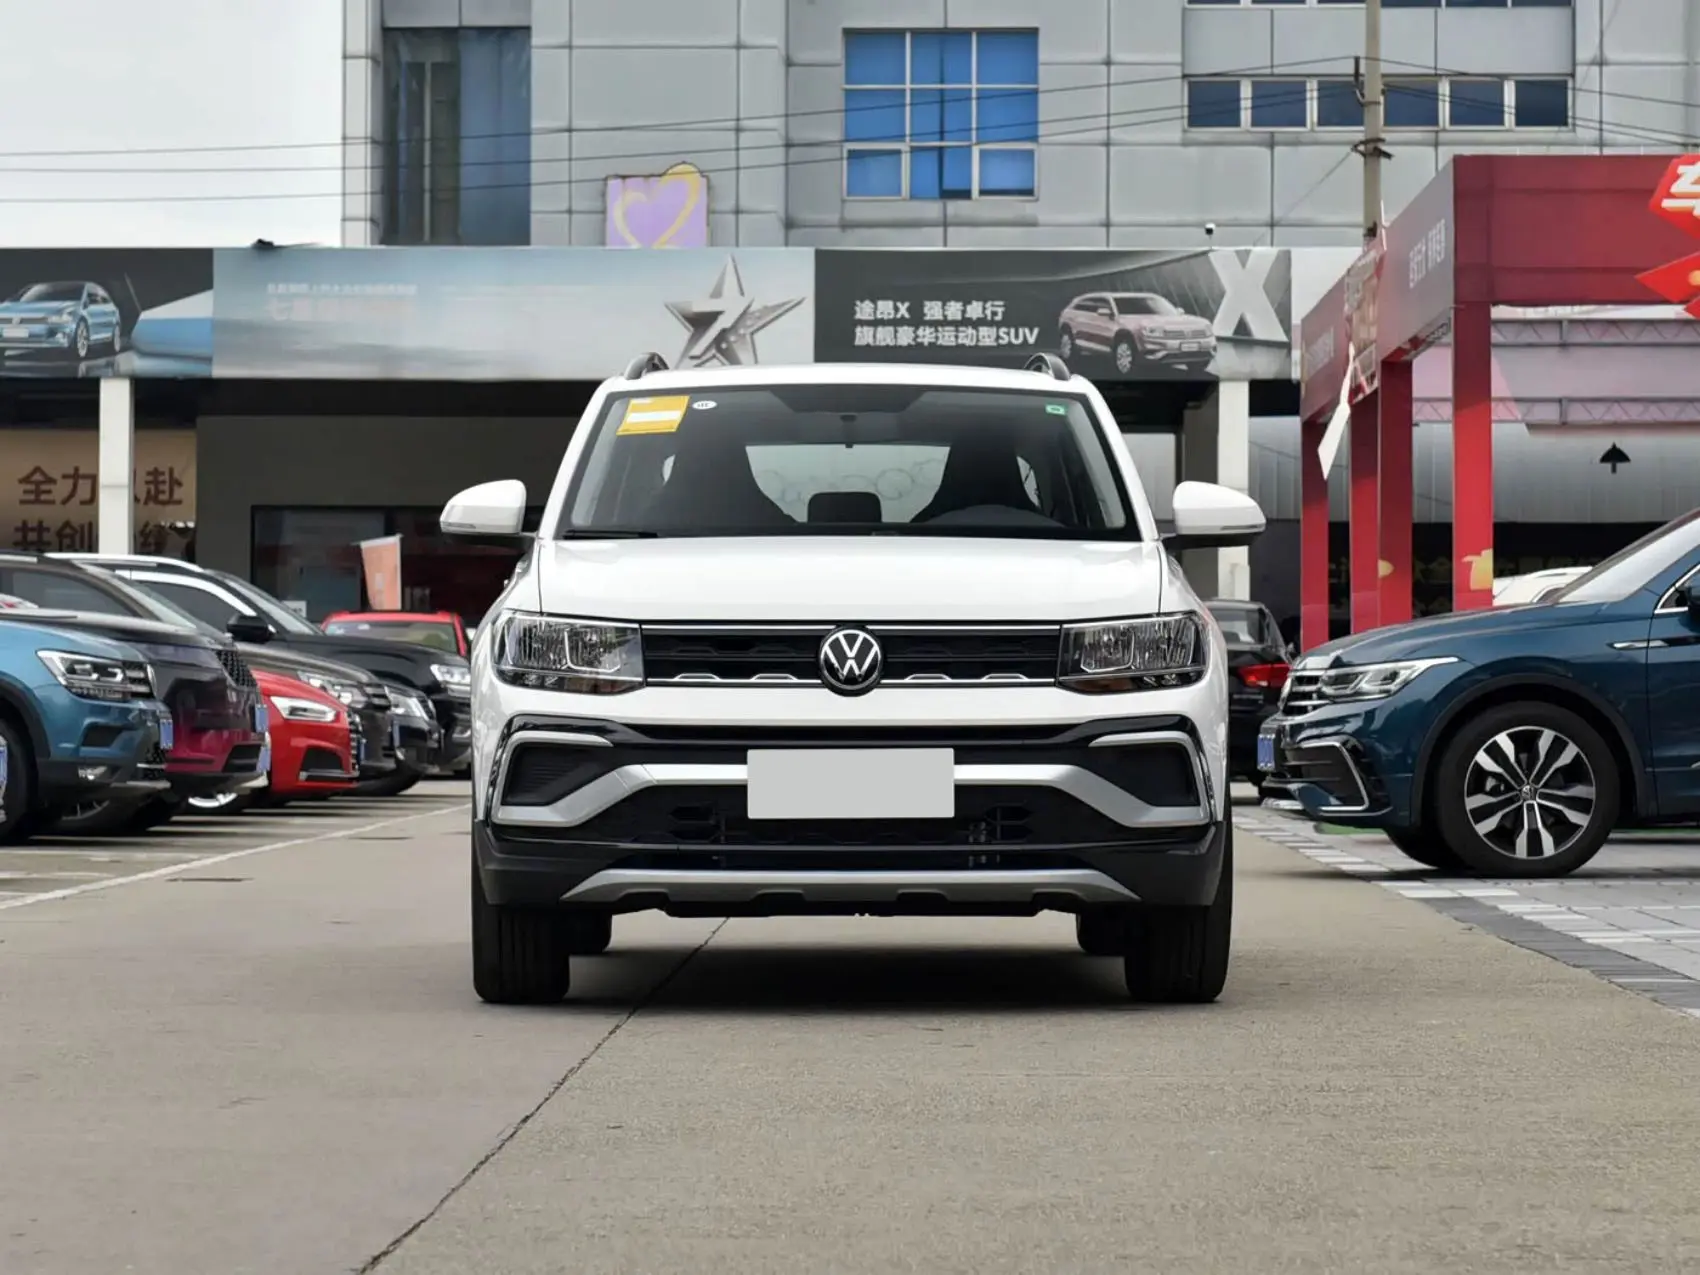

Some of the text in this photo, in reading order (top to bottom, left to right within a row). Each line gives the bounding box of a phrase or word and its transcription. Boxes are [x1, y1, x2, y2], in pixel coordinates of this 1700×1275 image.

[854, 300, 1005, 321] 途昂X 强者卓行
[854, 326, 1040, 346] 旗舰豪华运动型SUV
[17, 464, 184, 506] 全力赴
